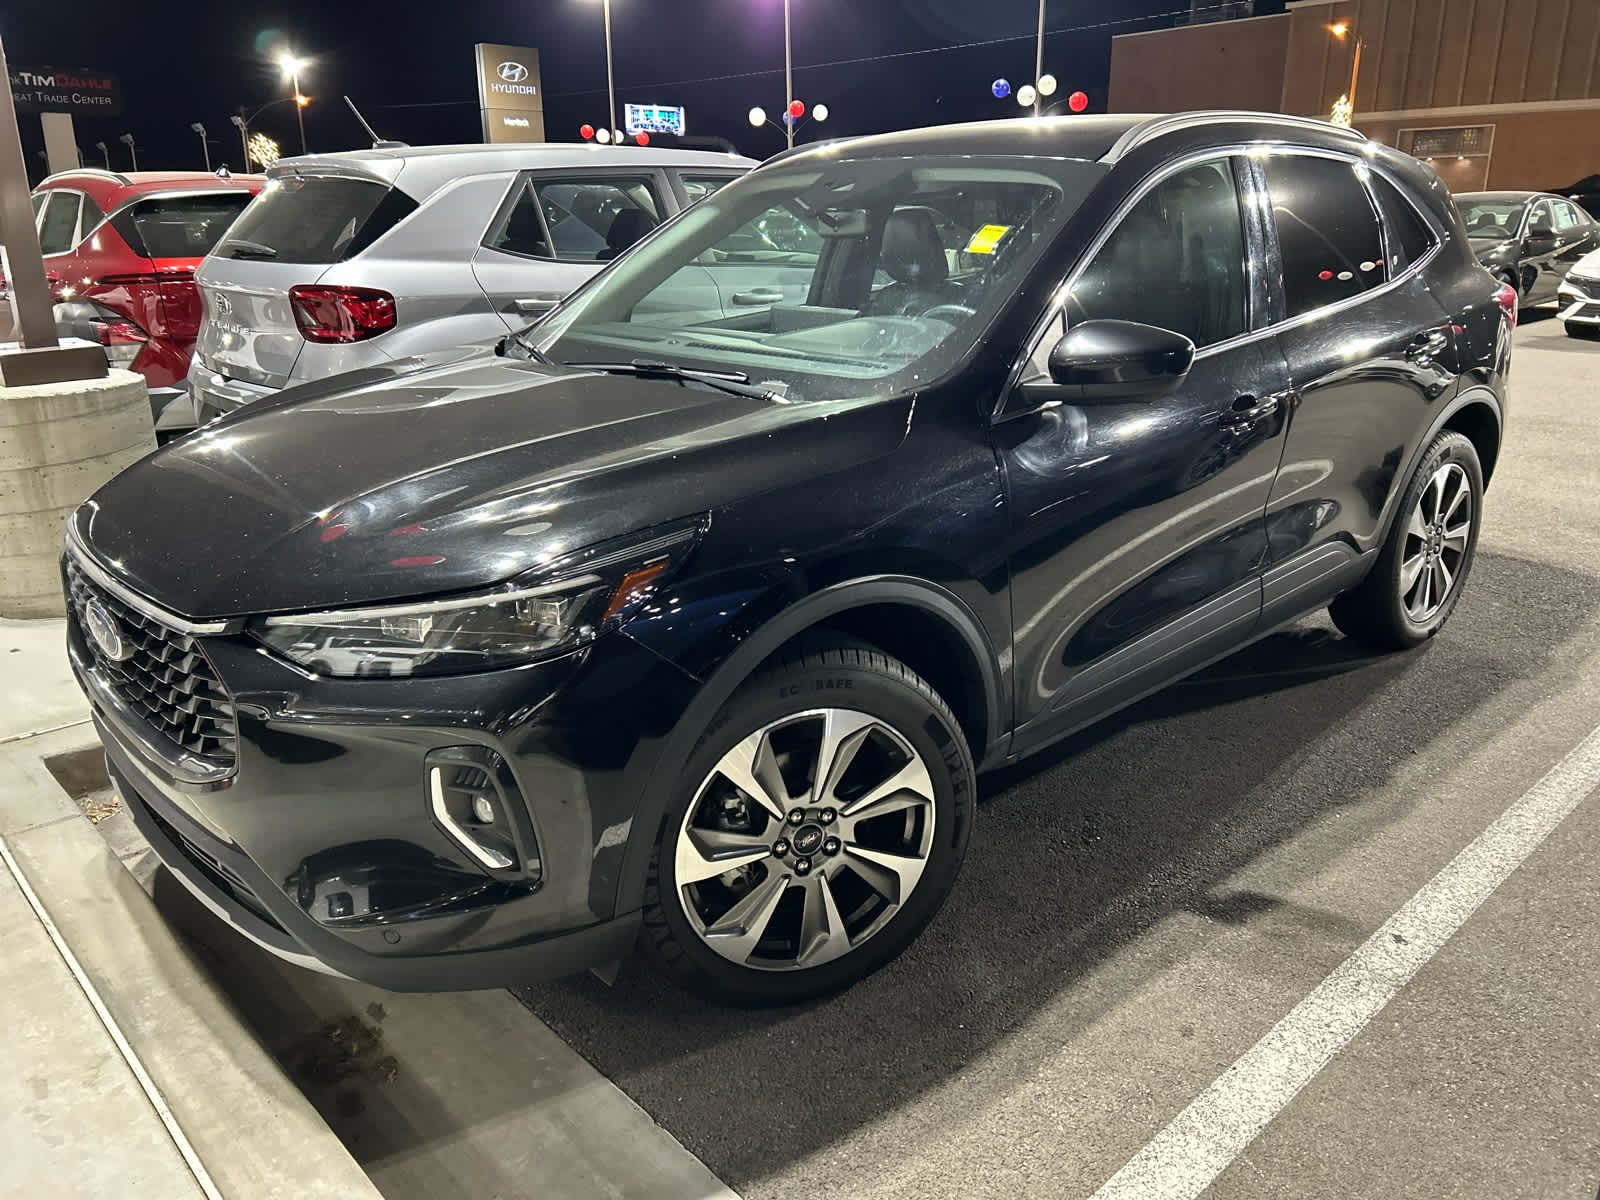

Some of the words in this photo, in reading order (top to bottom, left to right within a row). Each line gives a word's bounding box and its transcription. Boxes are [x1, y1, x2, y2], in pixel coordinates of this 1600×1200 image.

[491, 83, 537, 95] HYUNDAI
[14, 93, 32, 102] EAT
[72, 93, 112, 105] CENTER
